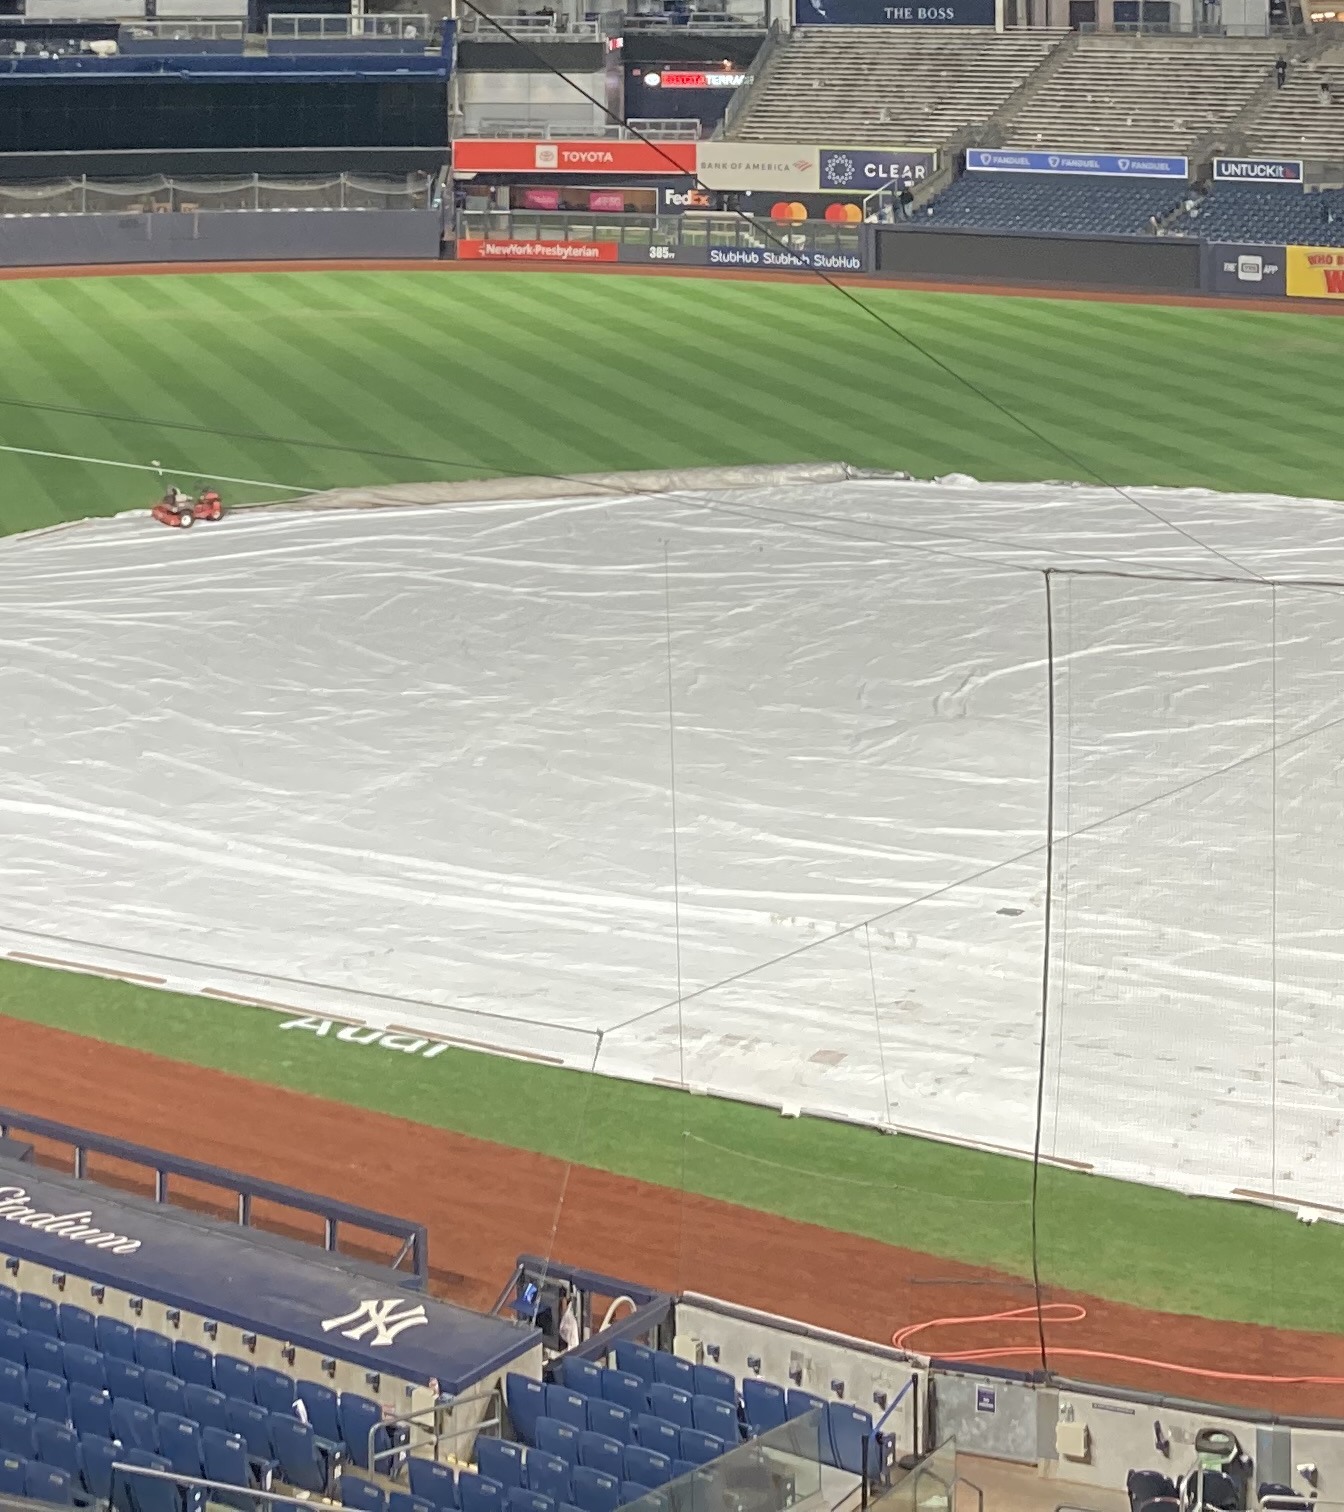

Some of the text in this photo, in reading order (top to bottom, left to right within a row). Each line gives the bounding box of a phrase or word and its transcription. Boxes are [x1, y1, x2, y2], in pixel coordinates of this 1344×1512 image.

[884, 7, 954, 19] THE BOSS
[562, 151, 613, 163] TOYOTA
[993, 156, 1031, 166] FANDUEL
[701, 161, 790, 172] BANK OF AMERICA
[1061, 158, 1100, 169] FANDUEL
[1131, 161, 1170, 171] FANDUEL
[864, 163, 925, 179] CLEAR
[1221, 162, 1285, 178] UNTUCKit
[665, 189, 710, 206] FedEx
[649, 246, 669, 259] 385
[711, 249, 759, 264] StubHub
[763, 251, 810, 266] StubHub
[814, 254, 861, 269] StubHub
[1308, 255, 1333, 266] WHO
